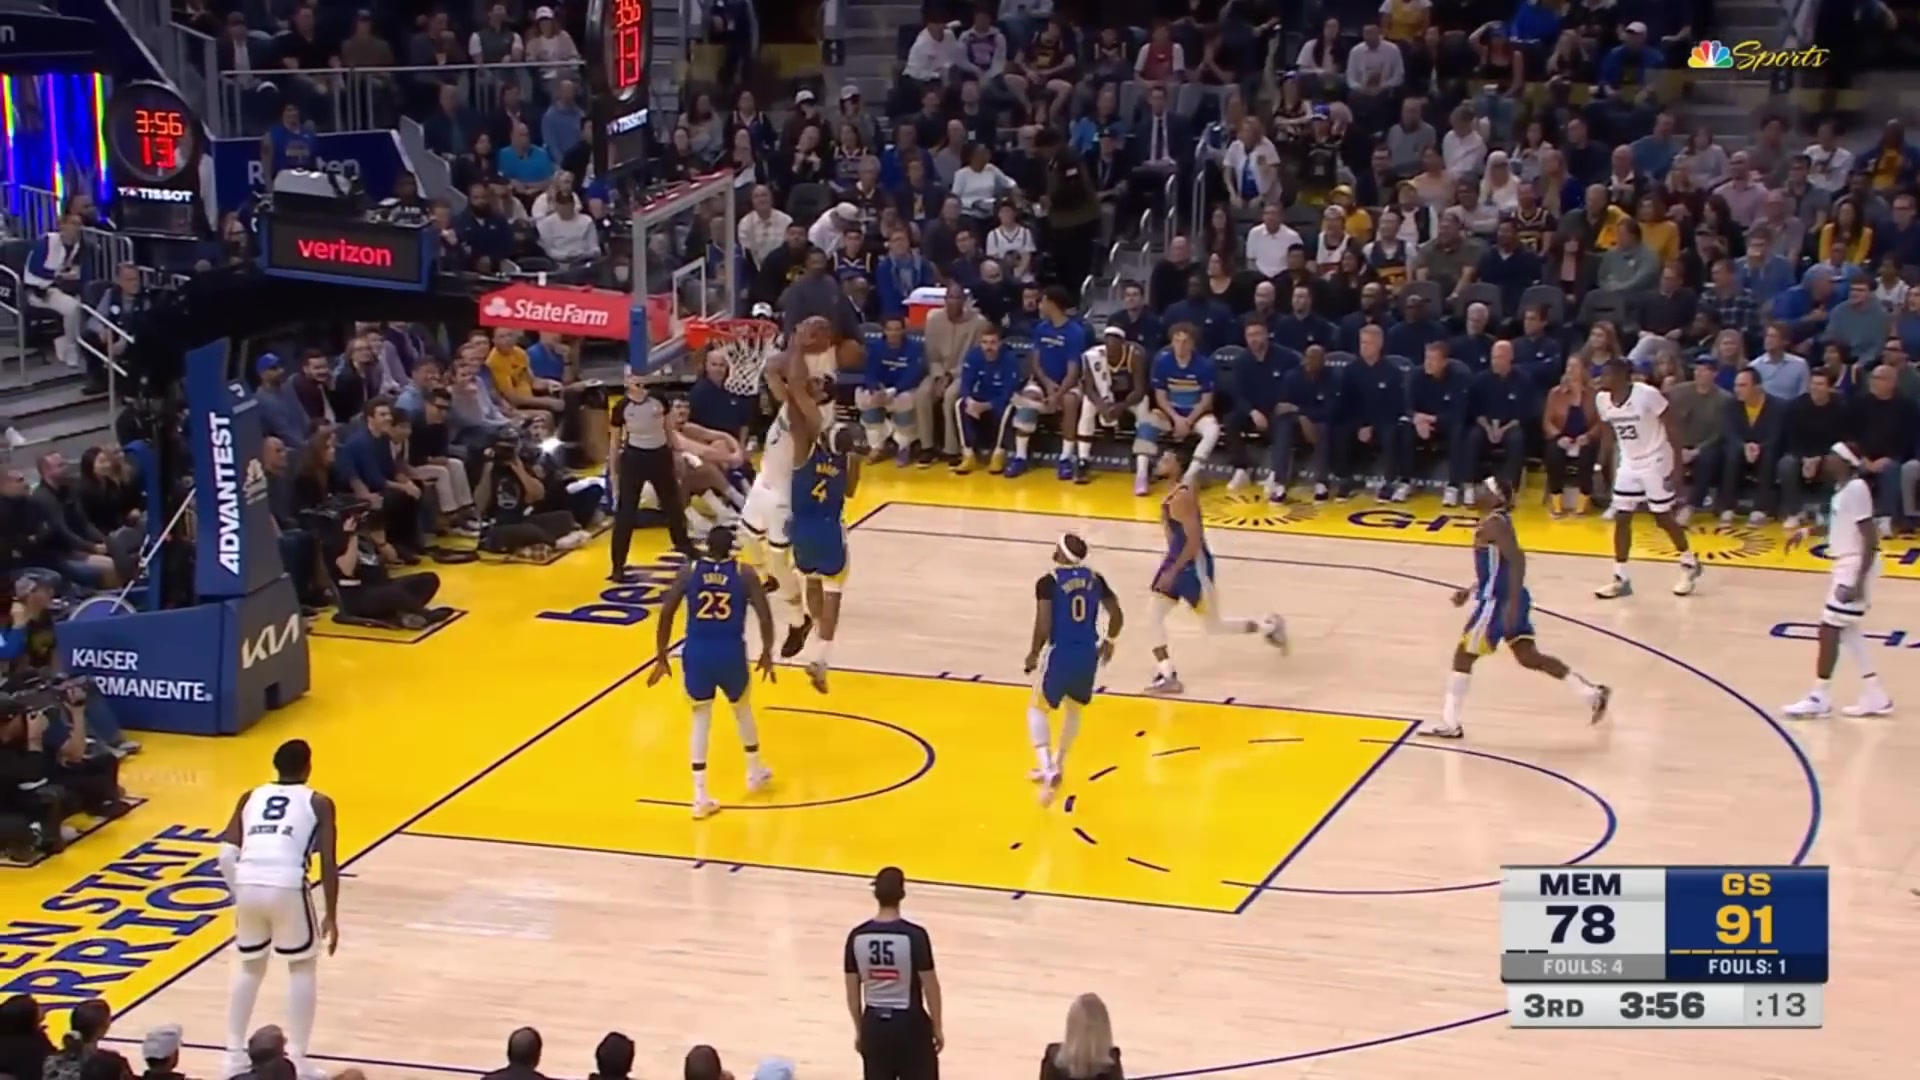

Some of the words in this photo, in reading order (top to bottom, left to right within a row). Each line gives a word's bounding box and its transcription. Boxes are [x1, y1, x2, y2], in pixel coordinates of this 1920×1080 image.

[135, 110, 184, 136] 3:56
[143, 136, 177, 168] 13
[298, 238, 392, 267] verizon
[1616, 425, 1638, 440] 23
[208, 411, 240, 577] ADVANTEST
[811, 479, 828, 503] 4
[695, 590, 732, 622] 23
[1071, 595, 1086, 622] 0
[71, 648, 139, 671] KAISER
[94, 675, 206, 702] RMANENTE
[262, 795, 291, 821] 8
[868, 940, 896, 967] 35
